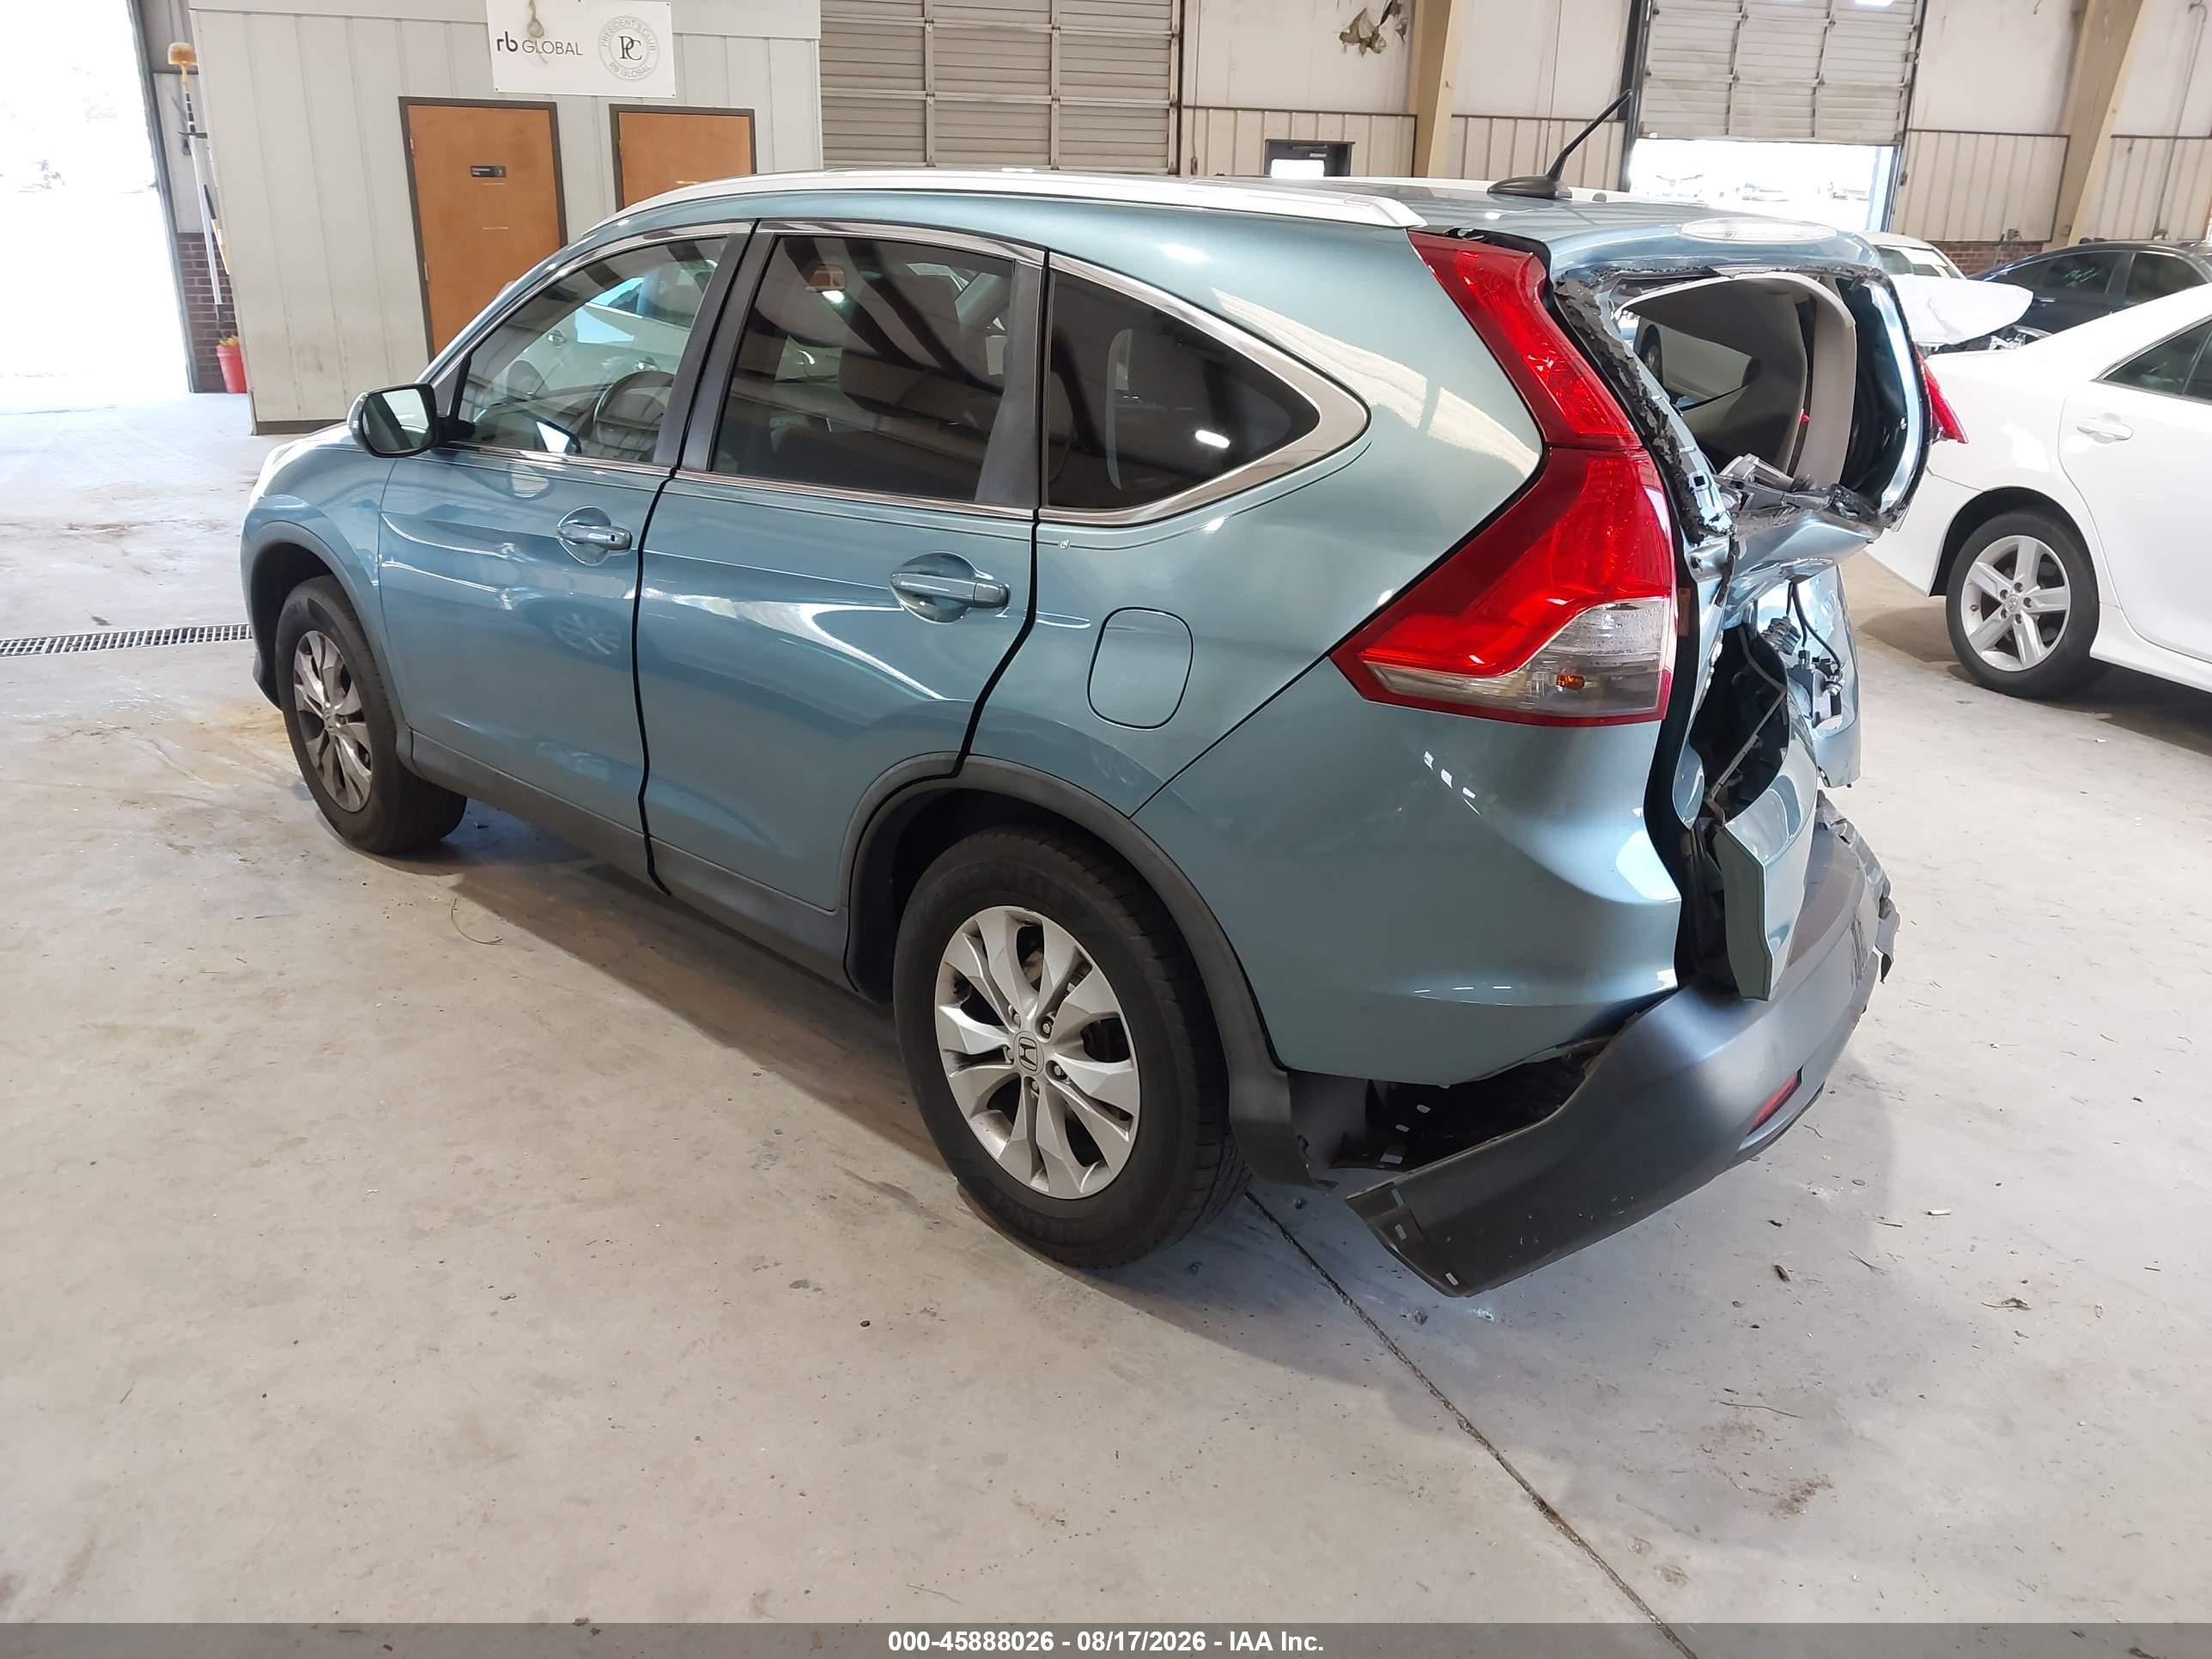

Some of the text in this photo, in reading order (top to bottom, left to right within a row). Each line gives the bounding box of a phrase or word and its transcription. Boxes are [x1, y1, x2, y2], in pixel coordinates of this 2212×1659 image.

[496, 31, 583, 56] rb GLOBAL
[620, 64, 653, 78] GLOBAL
